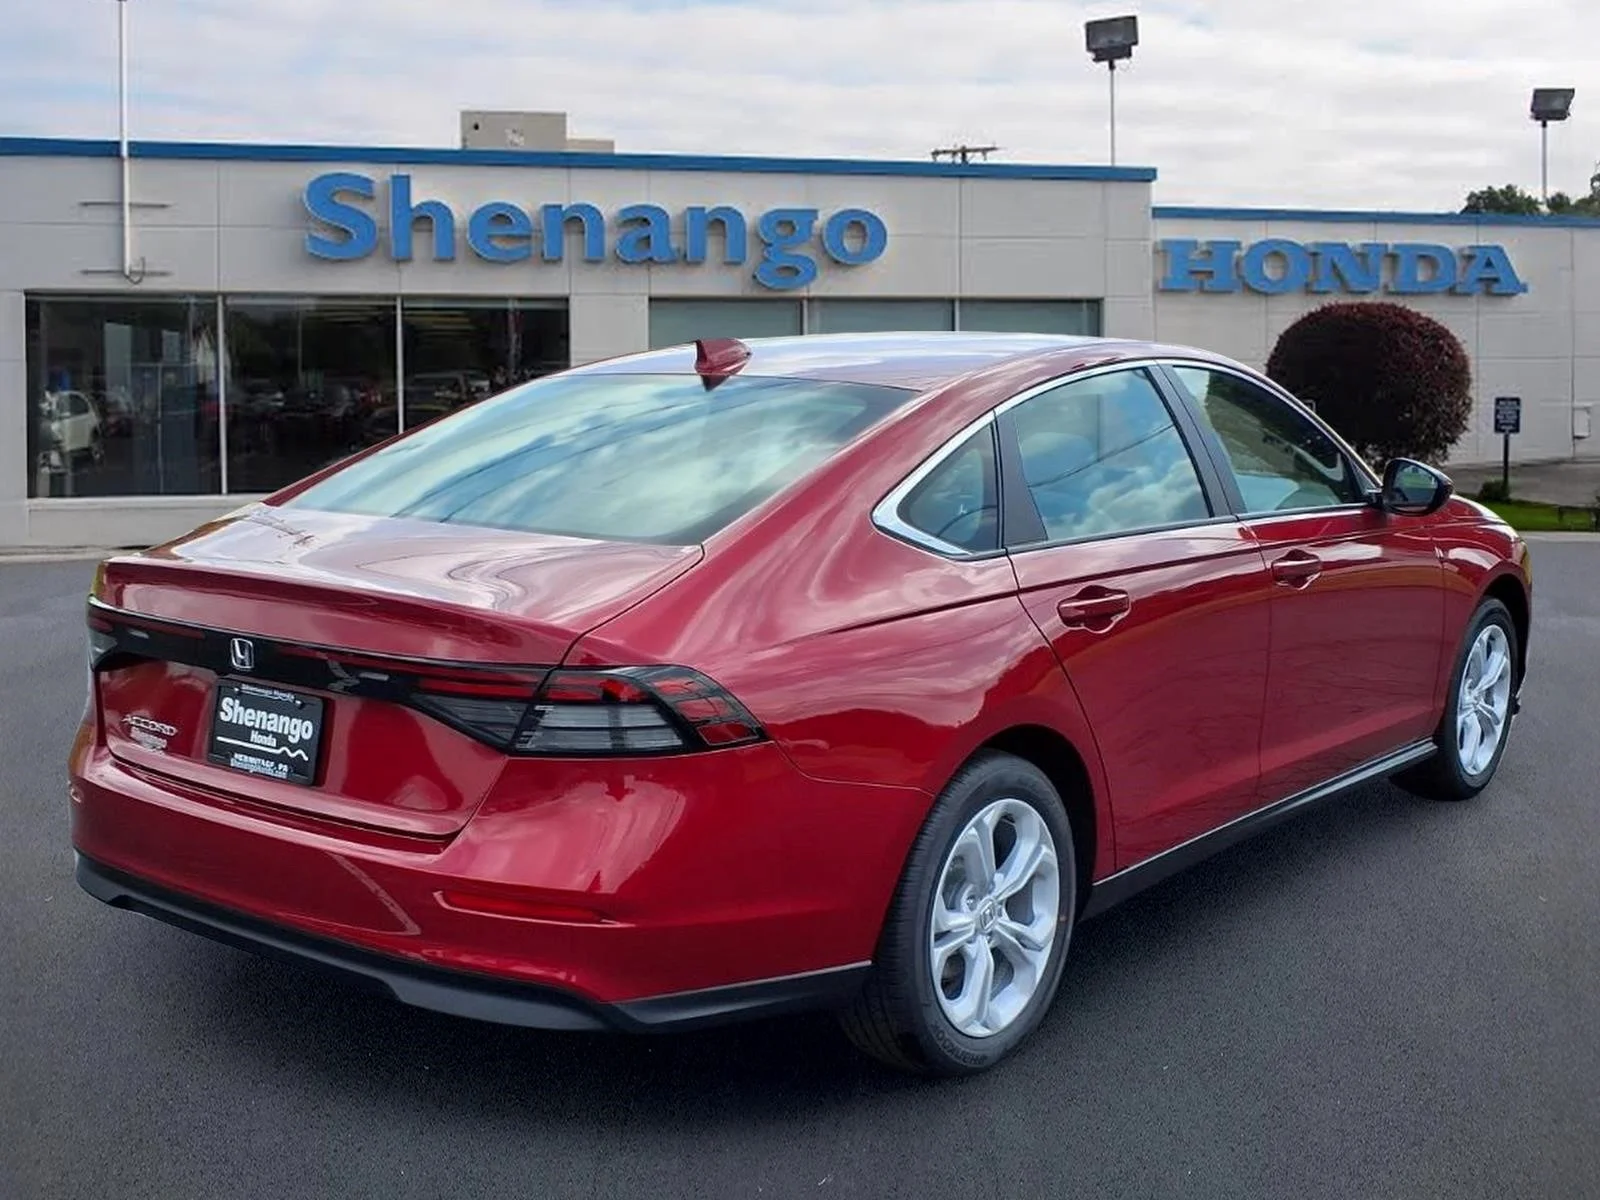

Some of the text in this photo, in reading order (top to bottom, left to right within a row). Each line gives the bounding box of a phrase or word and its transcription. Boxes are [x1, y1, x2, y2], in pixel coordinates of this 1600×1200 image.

[303, 171, 888, 290] Shenango
[1157, 238, 1527, 296] HONDA
[121, 714, 178, 736] ACCORD
[219, 697, 313, 743] Shenango
[250, 730, 277, 747] Honda
